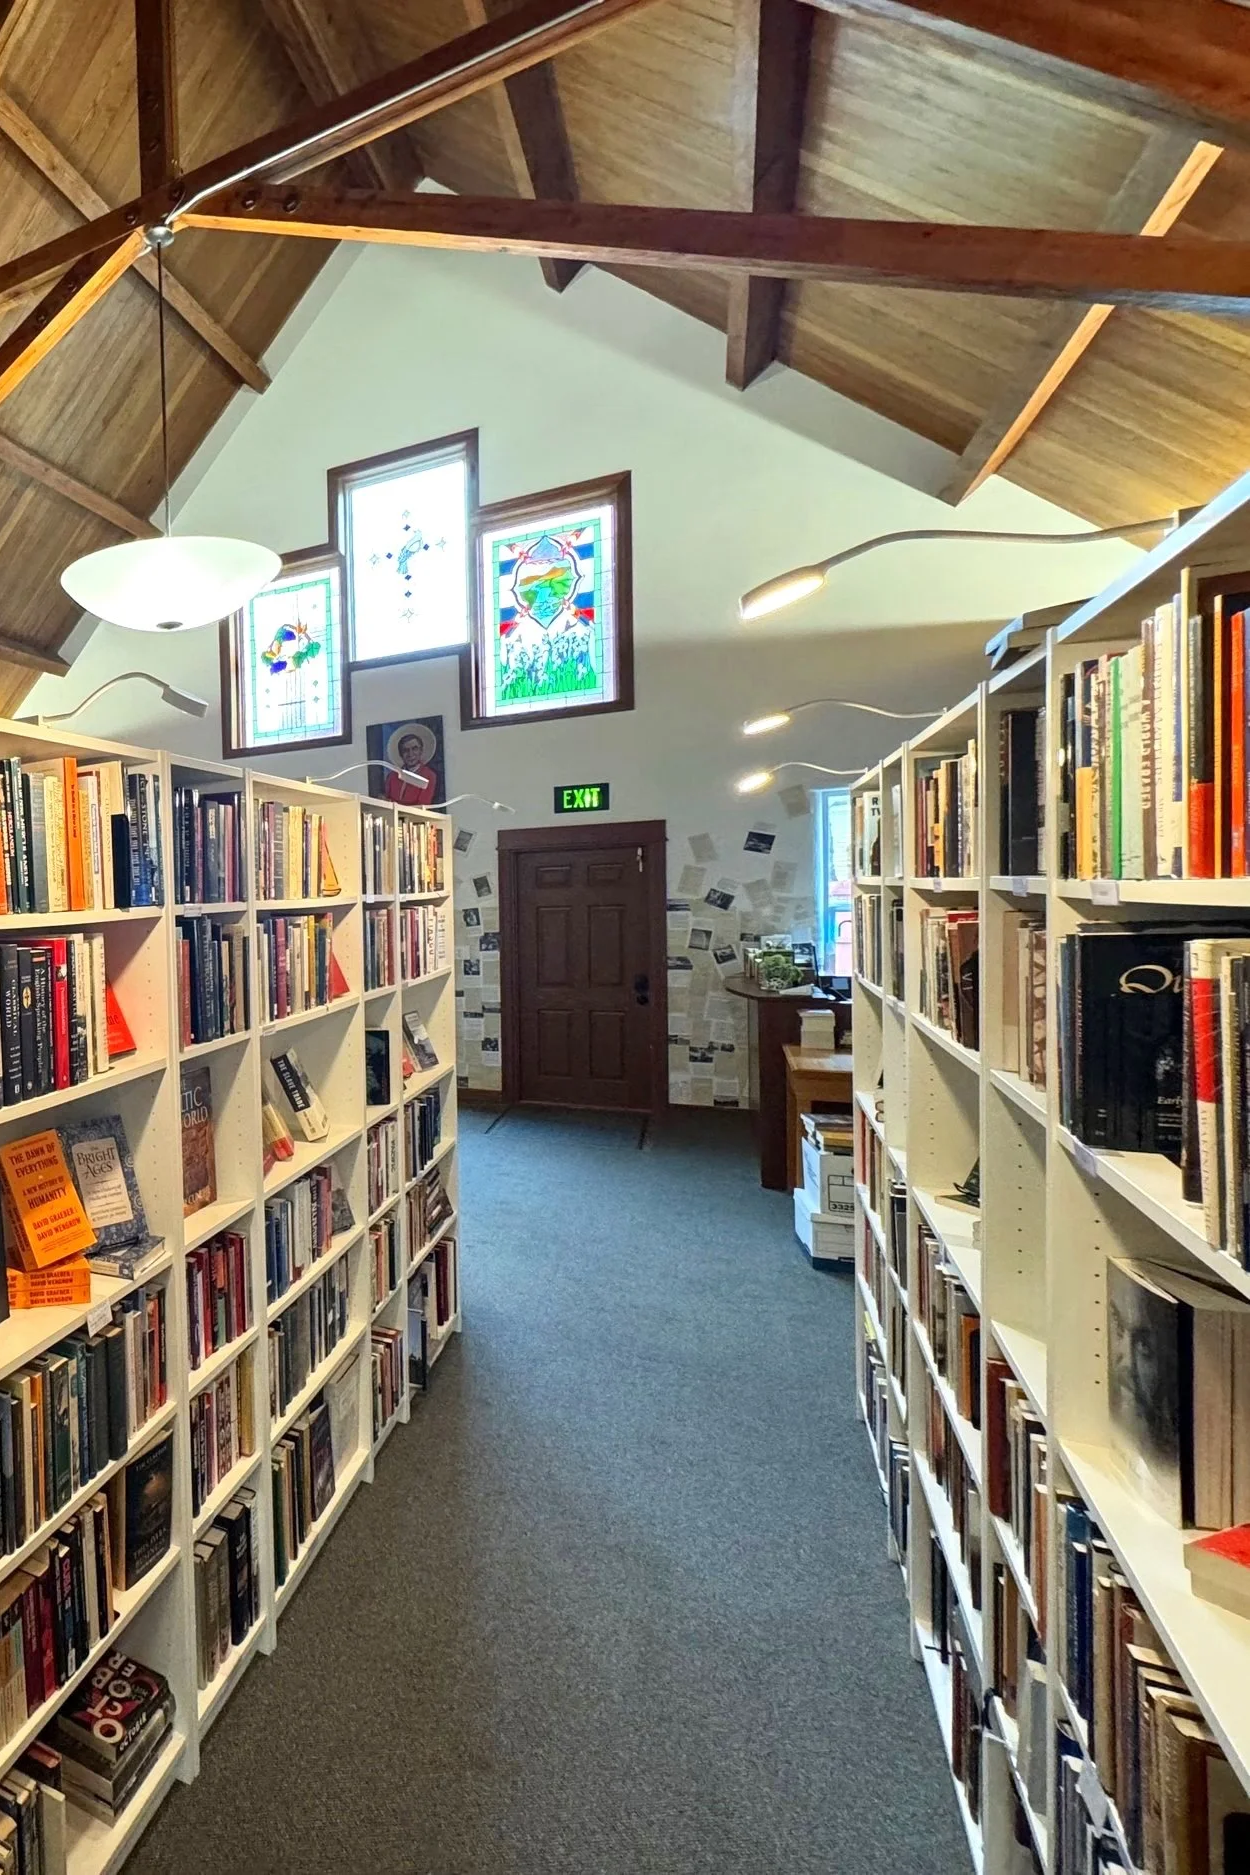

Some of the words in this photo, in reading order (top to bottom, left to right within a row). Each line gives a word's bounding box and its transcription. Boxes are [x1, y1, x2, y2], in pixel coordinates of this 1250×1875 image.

[563, 788, 600, 809] EXIT
[34, 968, 43, 1041] English-Speaking
[42, 1010, 46, 1020] of
[277, 1059, 288, 1071] THE
[282, 1071, 296, 1090] SLAVE
[181, 1087, 203, 1112] LTIC
[291, 1090, 306, 1109] TRADE
[183, 1106, 208, 1129] ORLD
[9, 1152, 25, 1165] THE
[26, 1146, 46, 1161] DAWN
[48, 1142, 56, 1154] OF
[76, 1147, 117, 1166] BRIGHT
[16, 1156, 58, 1178] EVERYTHING
[84, 1162, 113, 1178] AGES
[27, 1184, 39, 1194] NEW
[40, 1178, 57, 1190] HISTORY
[27, 1186, 67, 1209] HUMANITY
[32, 1217, 49, 1230] DAVID
[50, 1207, 74, 1224] GRAEBER
[37, 1229, 53, 1242] DAVID
[54, 1217, 81, 1236] WENGROW
[30, 1279, 45, 1287] DAVID
[46, 1296, 73, 1304] WENGROW
